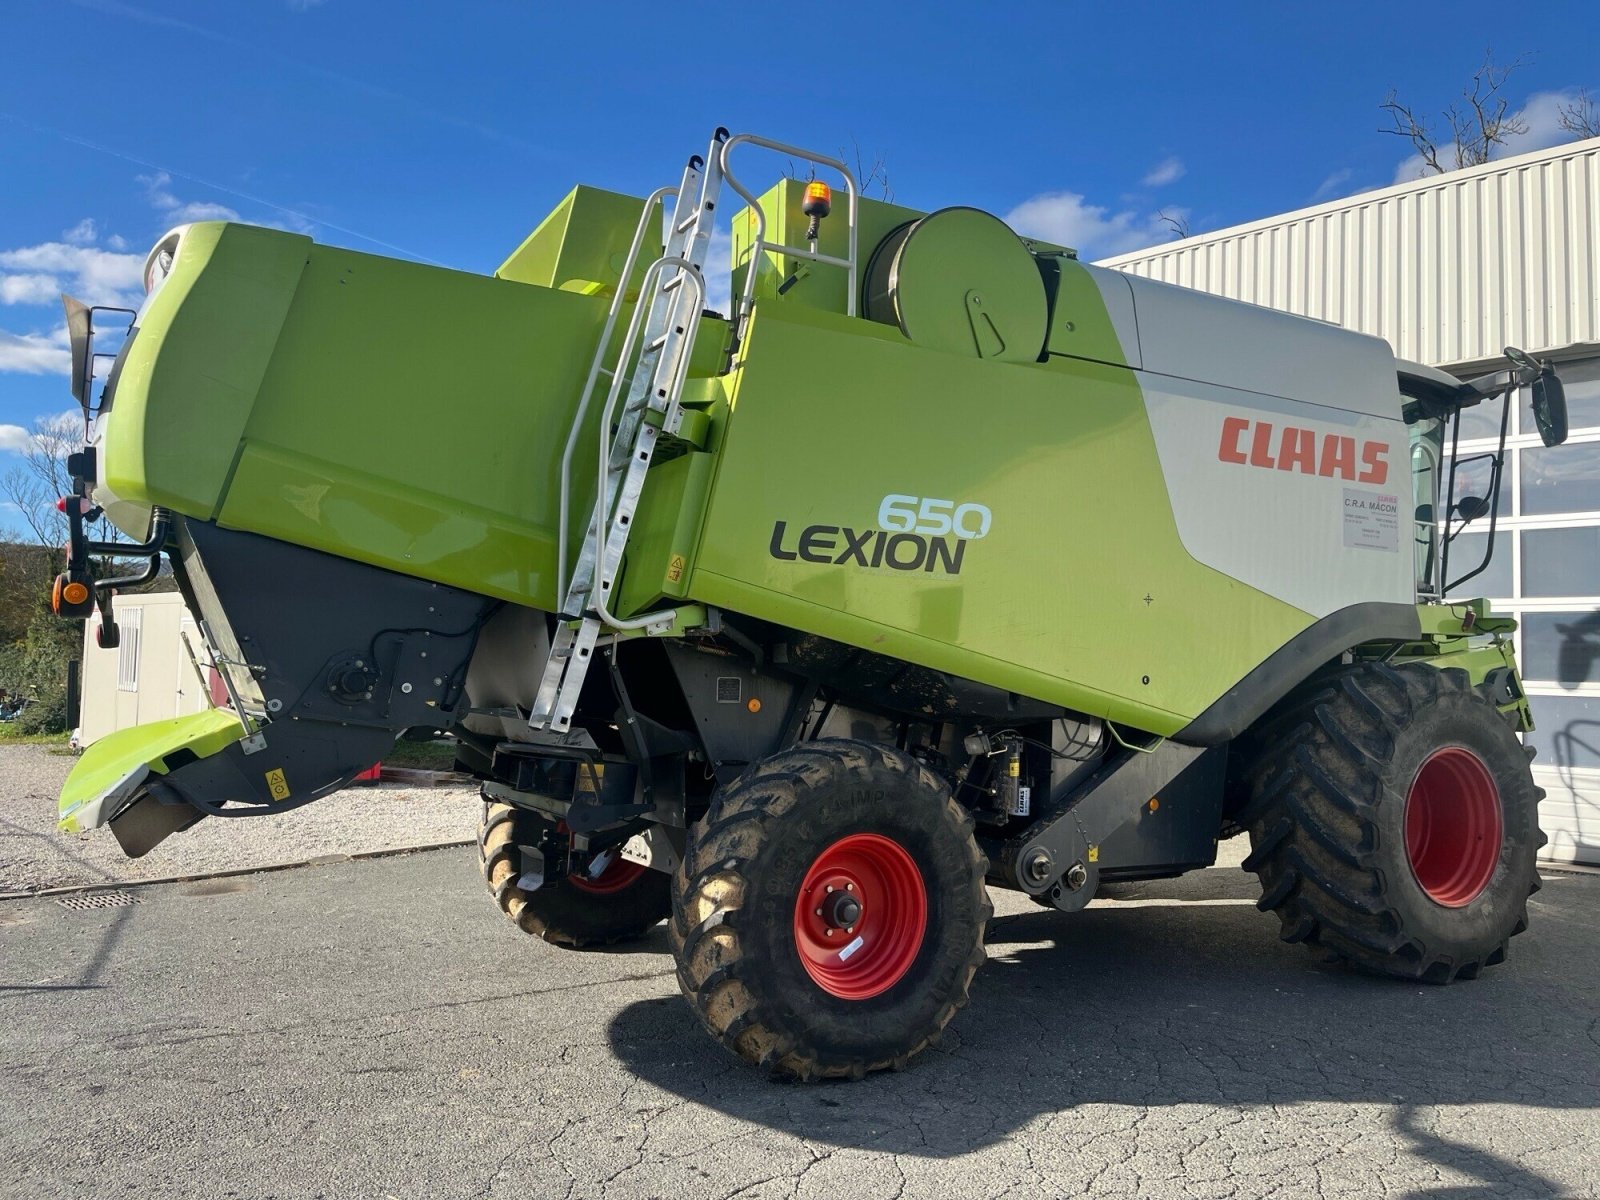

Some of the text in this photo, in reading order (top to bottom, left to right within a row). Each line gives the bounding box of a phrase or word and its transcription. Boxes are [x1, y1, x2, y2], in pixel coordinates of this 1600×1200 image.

[1219, 416, 1389, 485] CLAAS
[878, 494, 992, 539] 650
[1344, 498, 1367, 508] C.R.A.
[770, 521, 966, 574] LEXION
